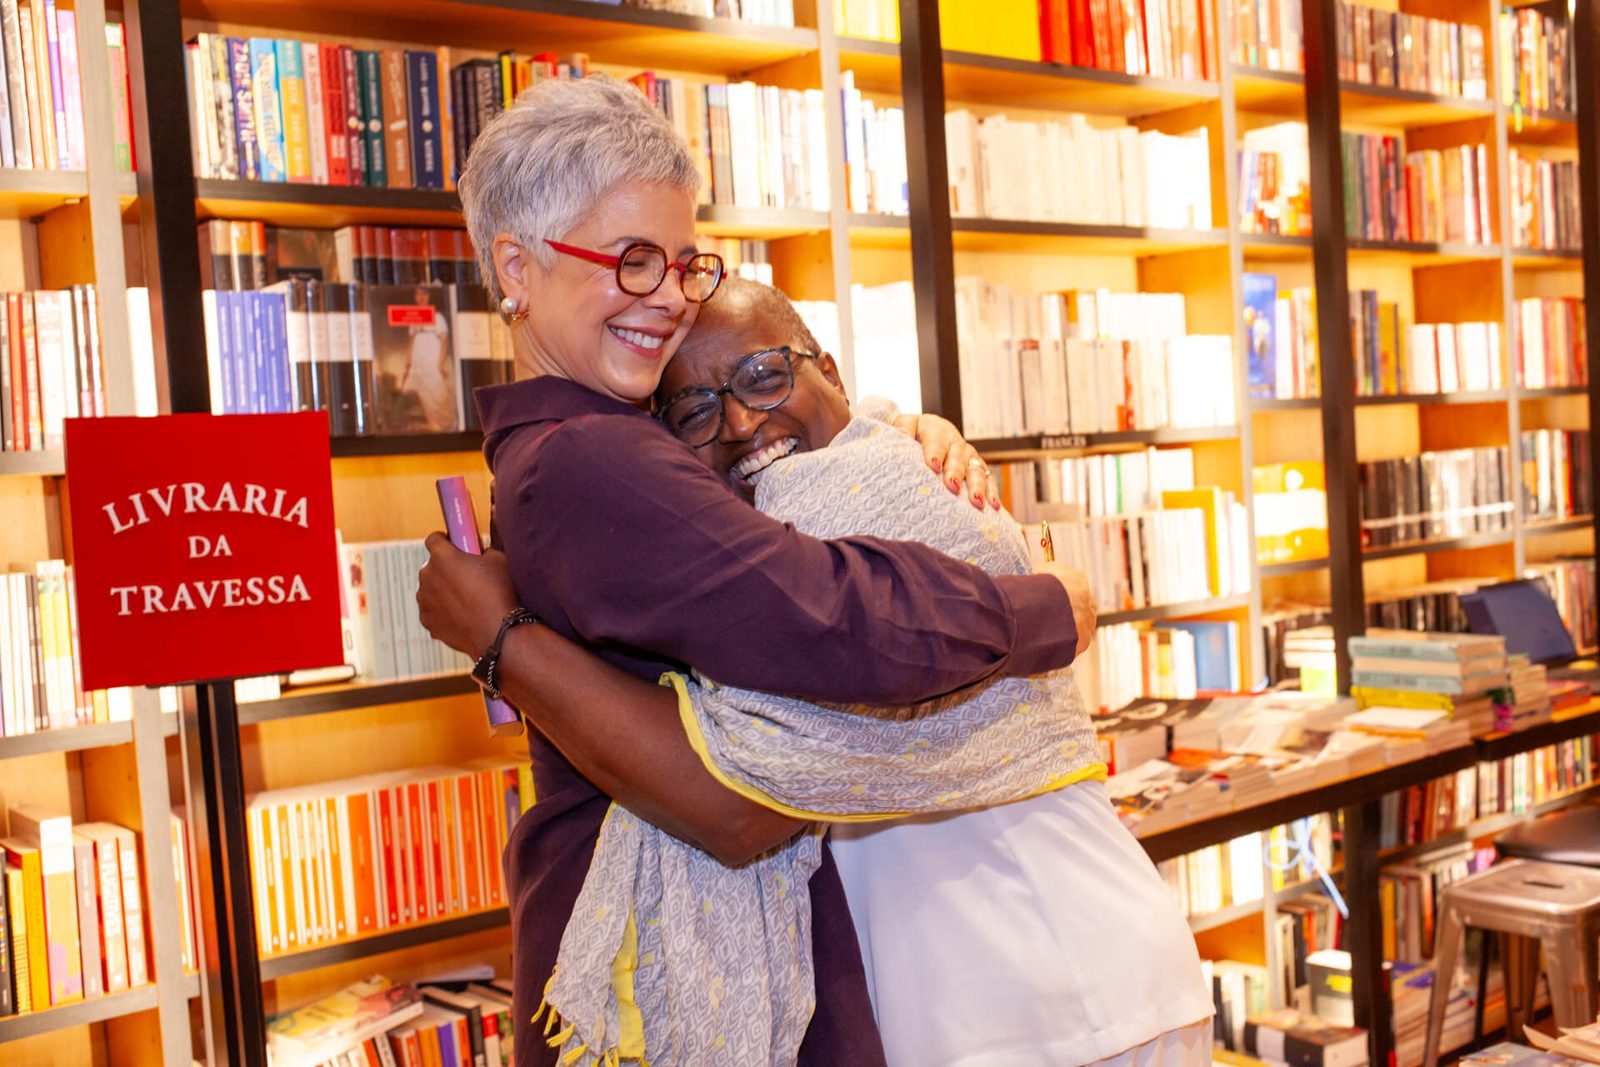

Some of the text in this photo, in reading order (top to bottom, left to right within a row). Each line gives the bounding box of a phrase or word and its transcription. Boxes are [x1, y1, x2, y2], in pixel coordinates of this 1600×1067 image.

[236, 90, 257, 142] SMITH
[103, 482, 309, 534] LIVRARIA
[188, 535, 232, 558] DA
[110, 574, 311, 616] TRAVESSA
